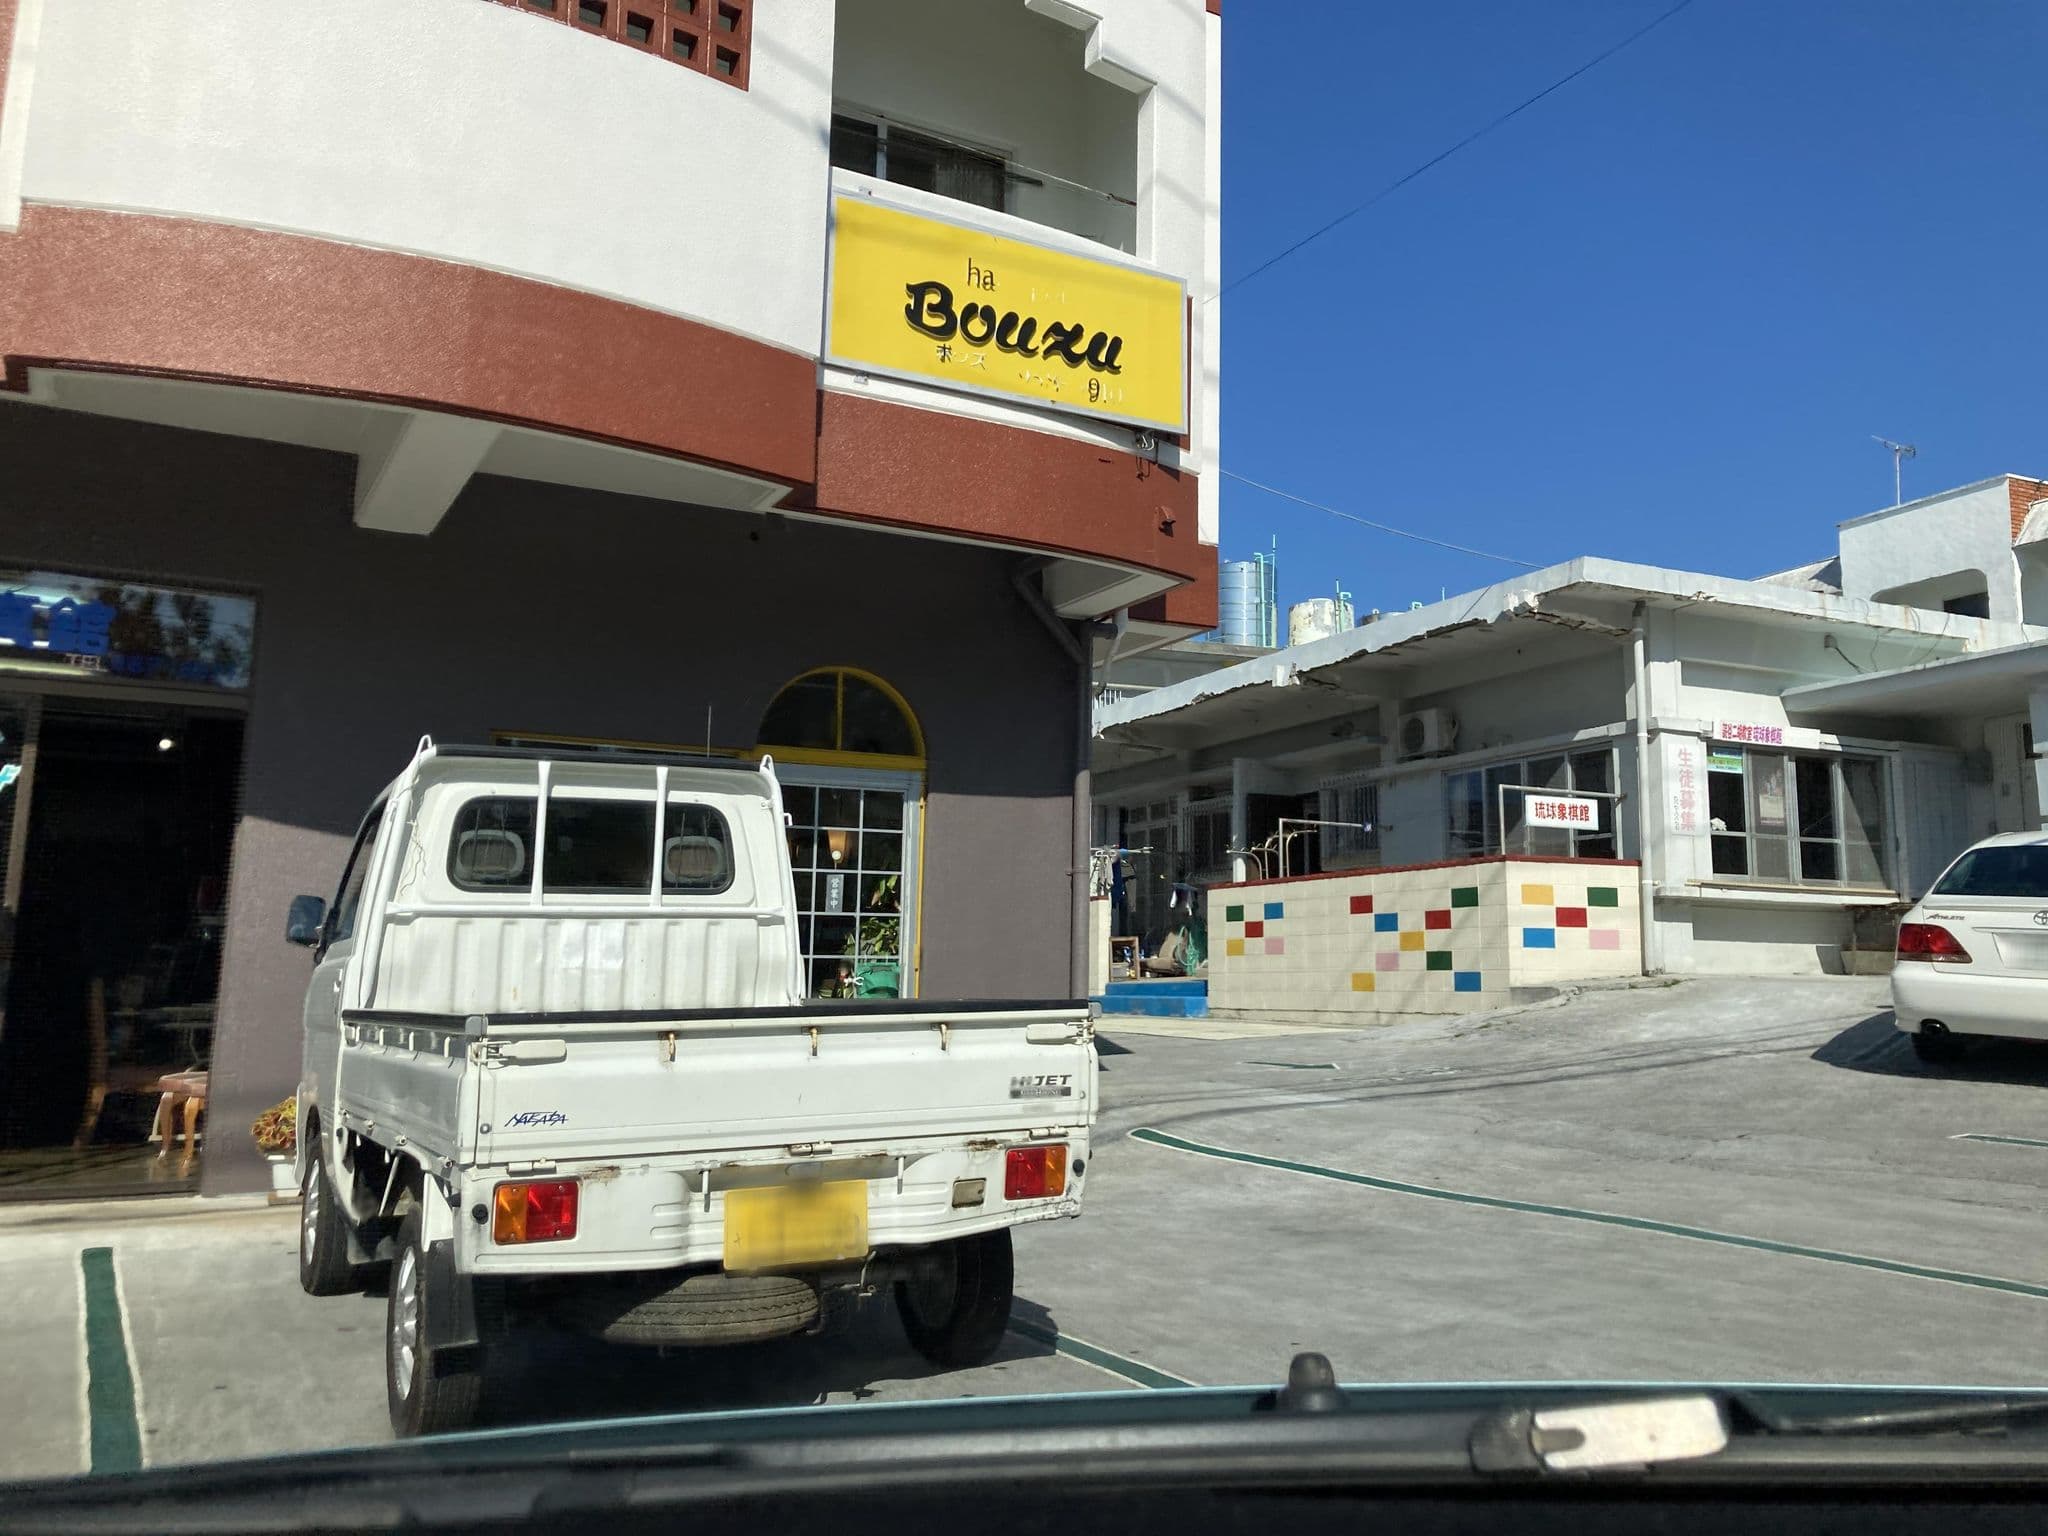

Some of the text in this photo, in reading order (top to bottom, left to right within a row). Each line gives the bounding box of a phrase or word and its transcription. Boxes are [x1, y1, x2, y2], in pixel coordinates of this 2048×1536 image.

[967, 257, 995, 292] ha
[904, 281, 1123, 374] Bouzu
[1678, 747, 1696, 831] 生徒募集
[1534, 801, 1590, 822] 琉球象棋館
[1010, 1074, 1072, 1086] HIJET
